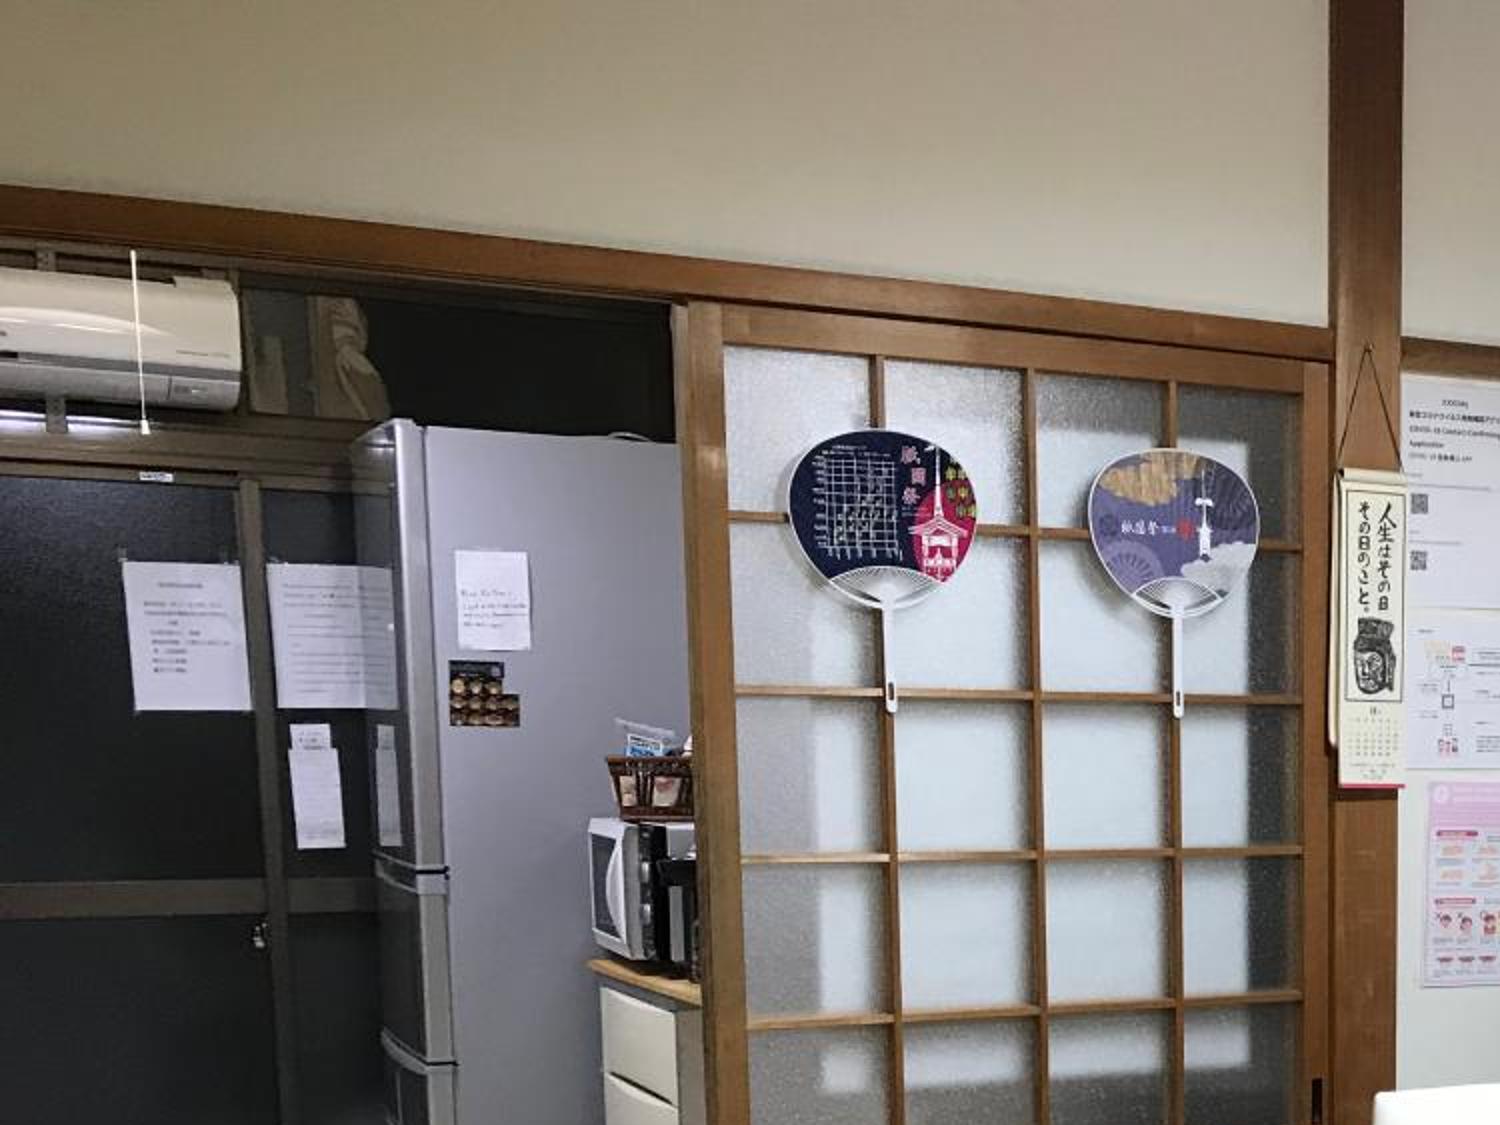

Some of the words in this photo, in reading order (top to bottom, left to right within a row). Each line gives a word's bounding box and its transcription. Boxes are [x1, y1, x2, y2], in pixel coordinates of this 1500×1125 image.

[1377, 501, 1397, 611] 人生はその日
